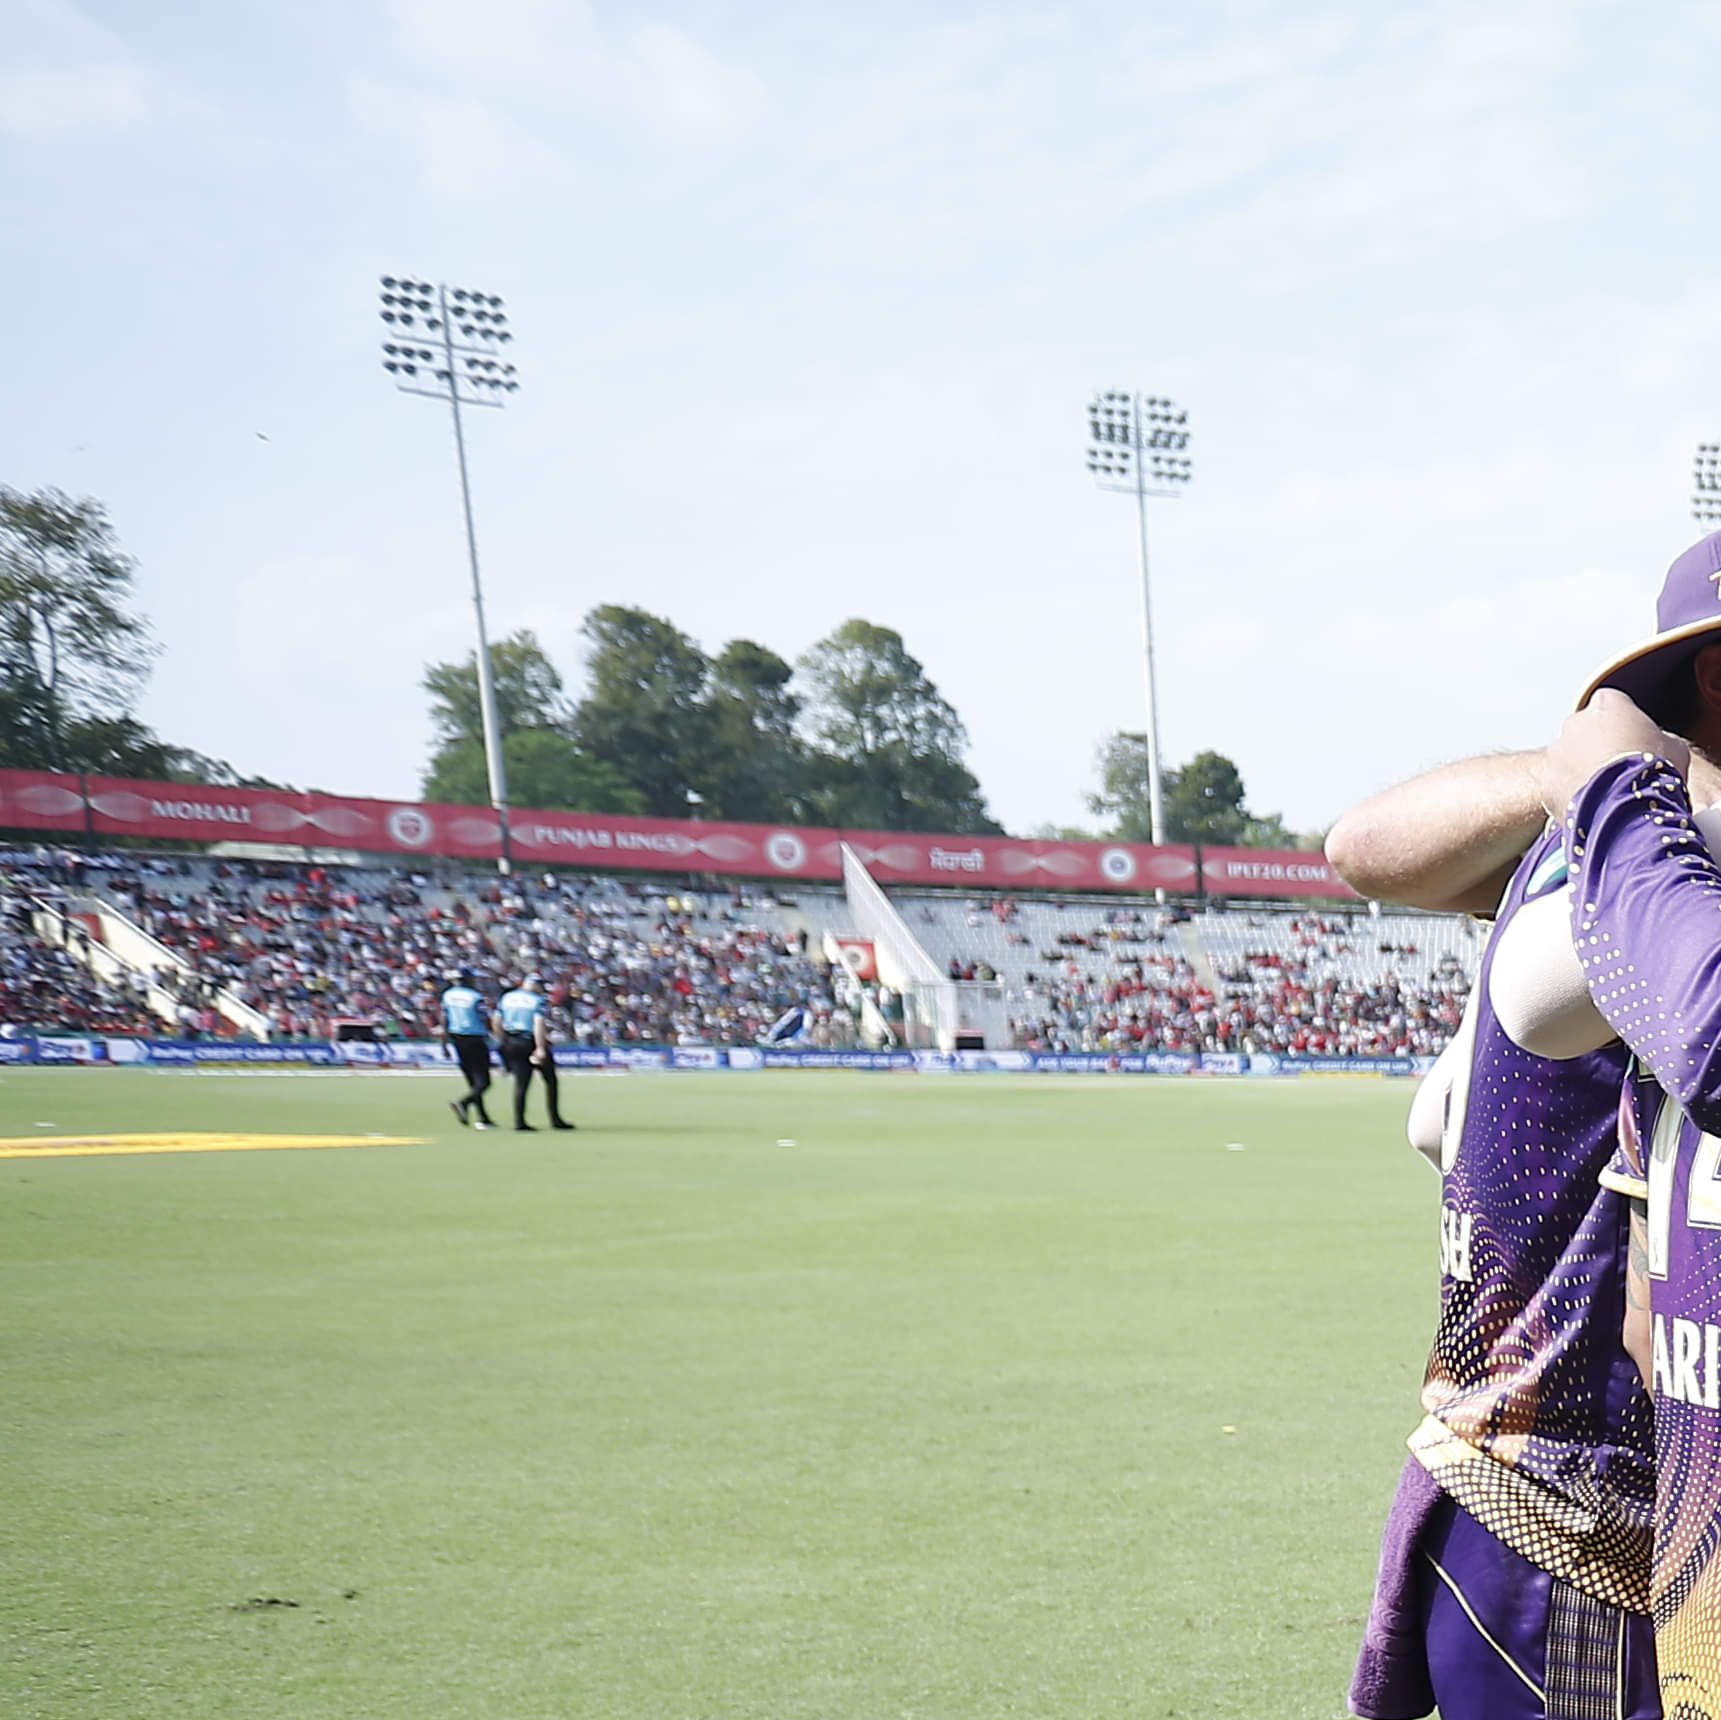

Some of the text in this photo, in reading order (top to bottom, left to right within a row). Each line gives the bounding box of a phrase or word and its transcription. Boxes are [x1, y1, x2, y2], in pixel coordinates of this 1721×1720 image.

[152, 799, 251, 824] MOHALI
[534, 826, 680, 852] PUNJAB KINGS
